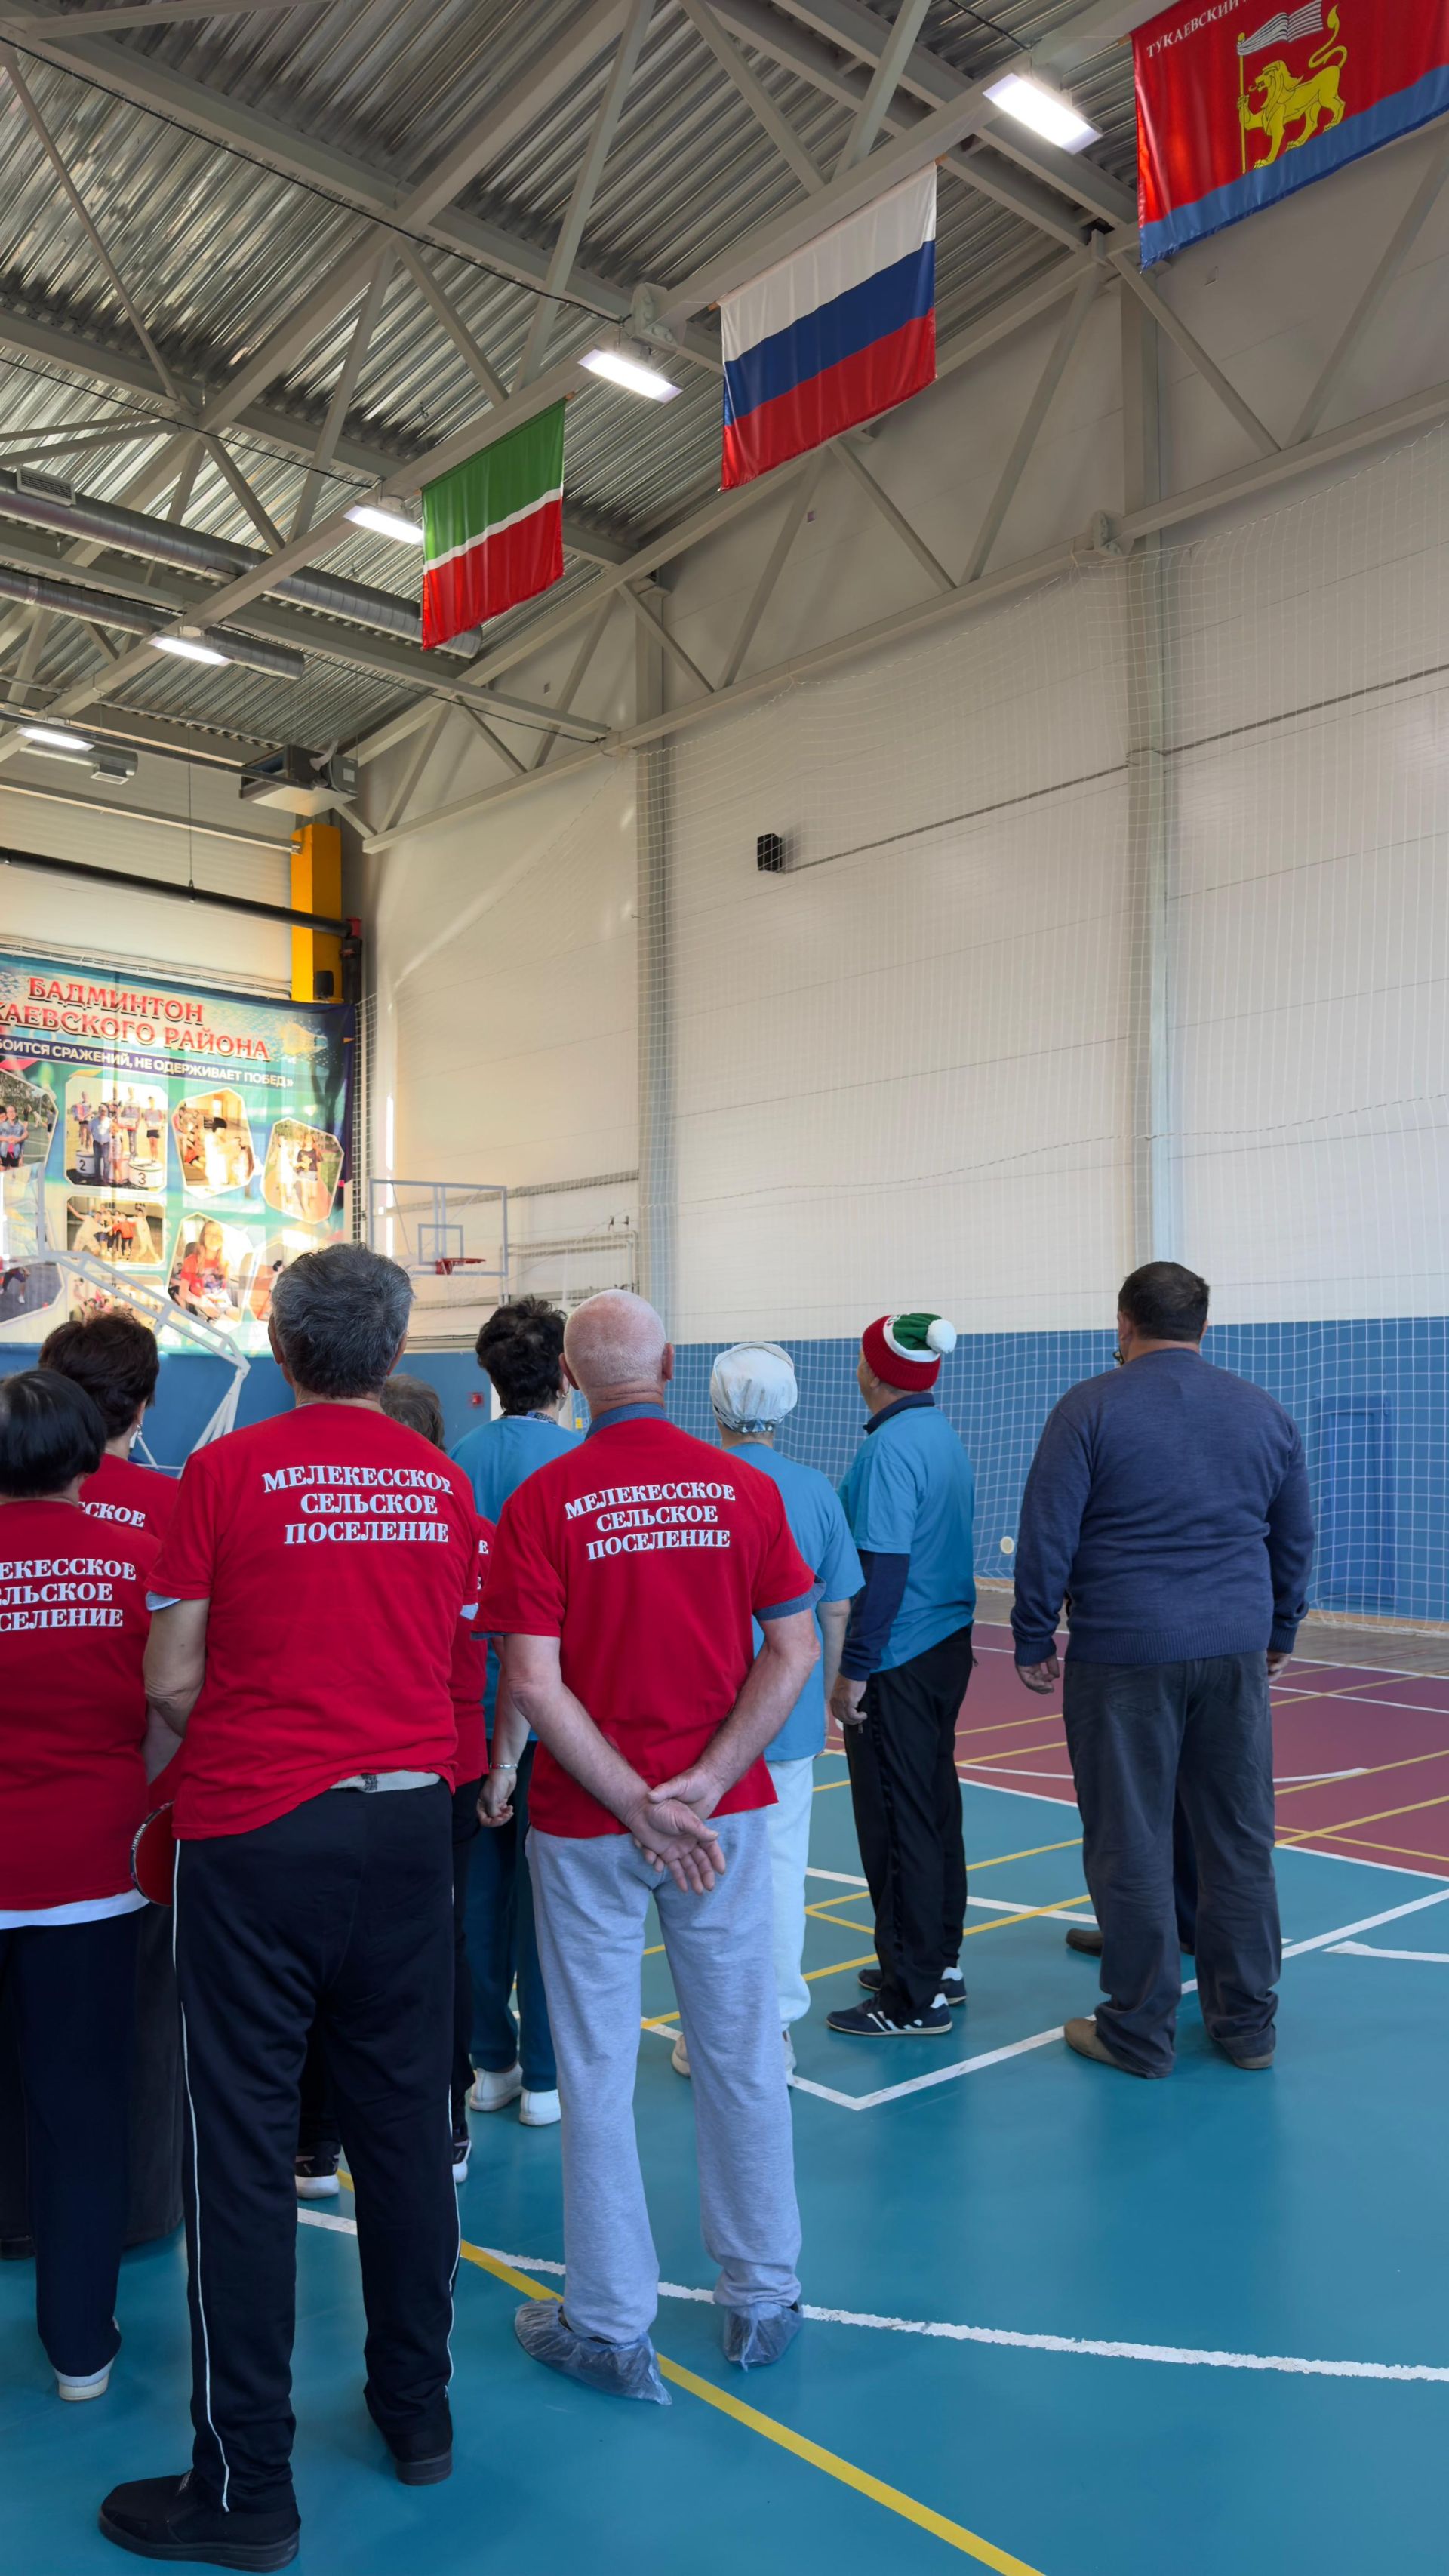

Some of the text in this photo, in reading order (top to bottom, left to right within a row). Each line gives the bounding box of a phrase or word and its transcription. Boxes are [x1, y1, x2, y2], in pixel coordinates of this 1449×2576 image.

[29, 977, 205, 1024] БАДМИНТОН
[163, 1026, 270, 1060] РАЙОНА
[0, 1038, 293, 1088] ОИТСЯ СРАЖЕНИЙ, НЕ ОДЕРЖИВАЕТ ПОБЕД»
[79, 1159, 86, 1171] 2
[138, 1172, 146, 1184] 3
[262, 1465, 454, 1494] МЕЛЕКЕССКОЕ
[300, 1493, 438, 1514] СЕЛЬСКОЕ
[565, 1482, 736, 1519] МЕЛЕКЕССКОЕ
[596, 1505, 718, 1531] СЕЛЬСКОЕ
[284, 1521, 448, 1544] ПОСЕЛЕНИЕ
[586, 1530, 730, 1560] ПОСЕЛЕНИЕ
[0, 1582, 112, 1606] ЛЬСКОЕ
